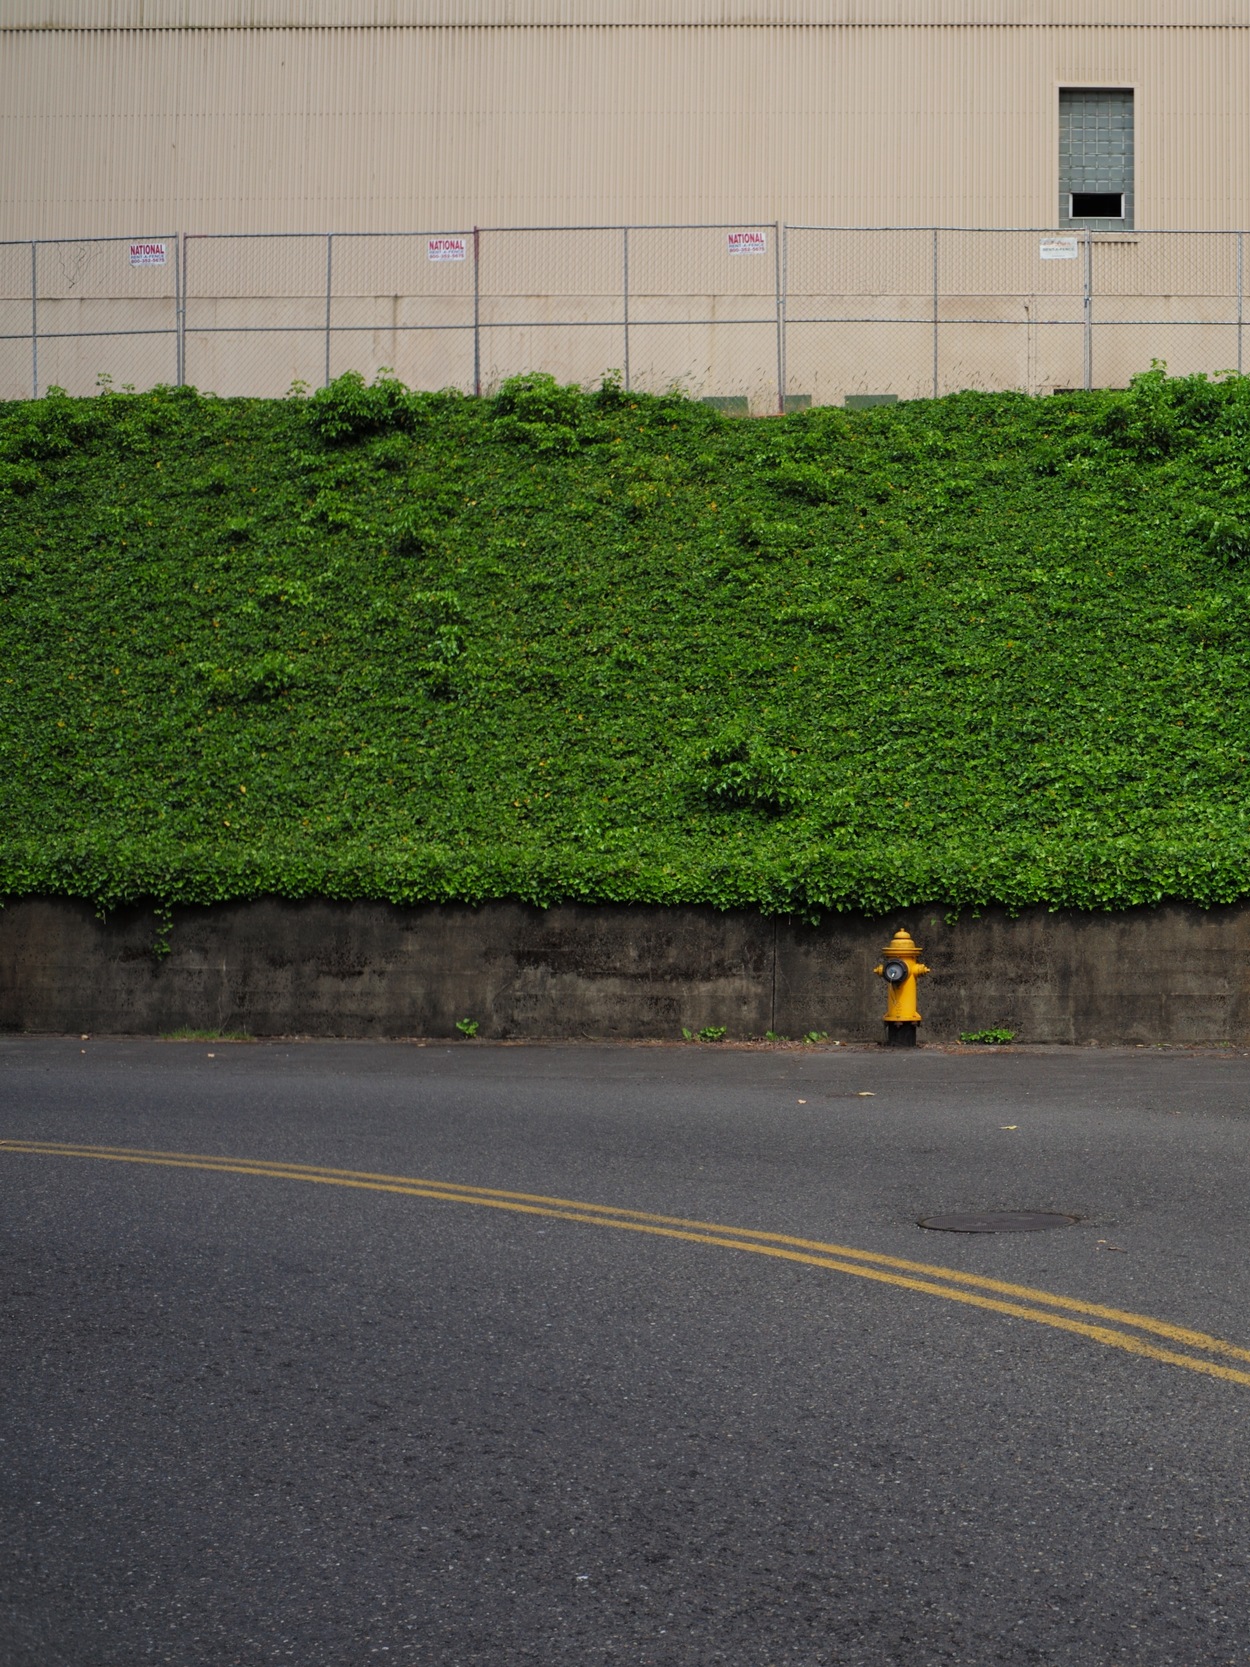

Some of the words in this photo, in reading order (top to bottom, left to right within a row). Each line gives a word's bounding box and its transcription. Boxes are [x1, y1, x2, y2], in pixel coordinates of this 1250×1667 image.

[728, 233, 764, 244] NATIONAL
[130, 244, 164, 255] NATIONAL
[429, 240, 464, 250] NATIONAL
